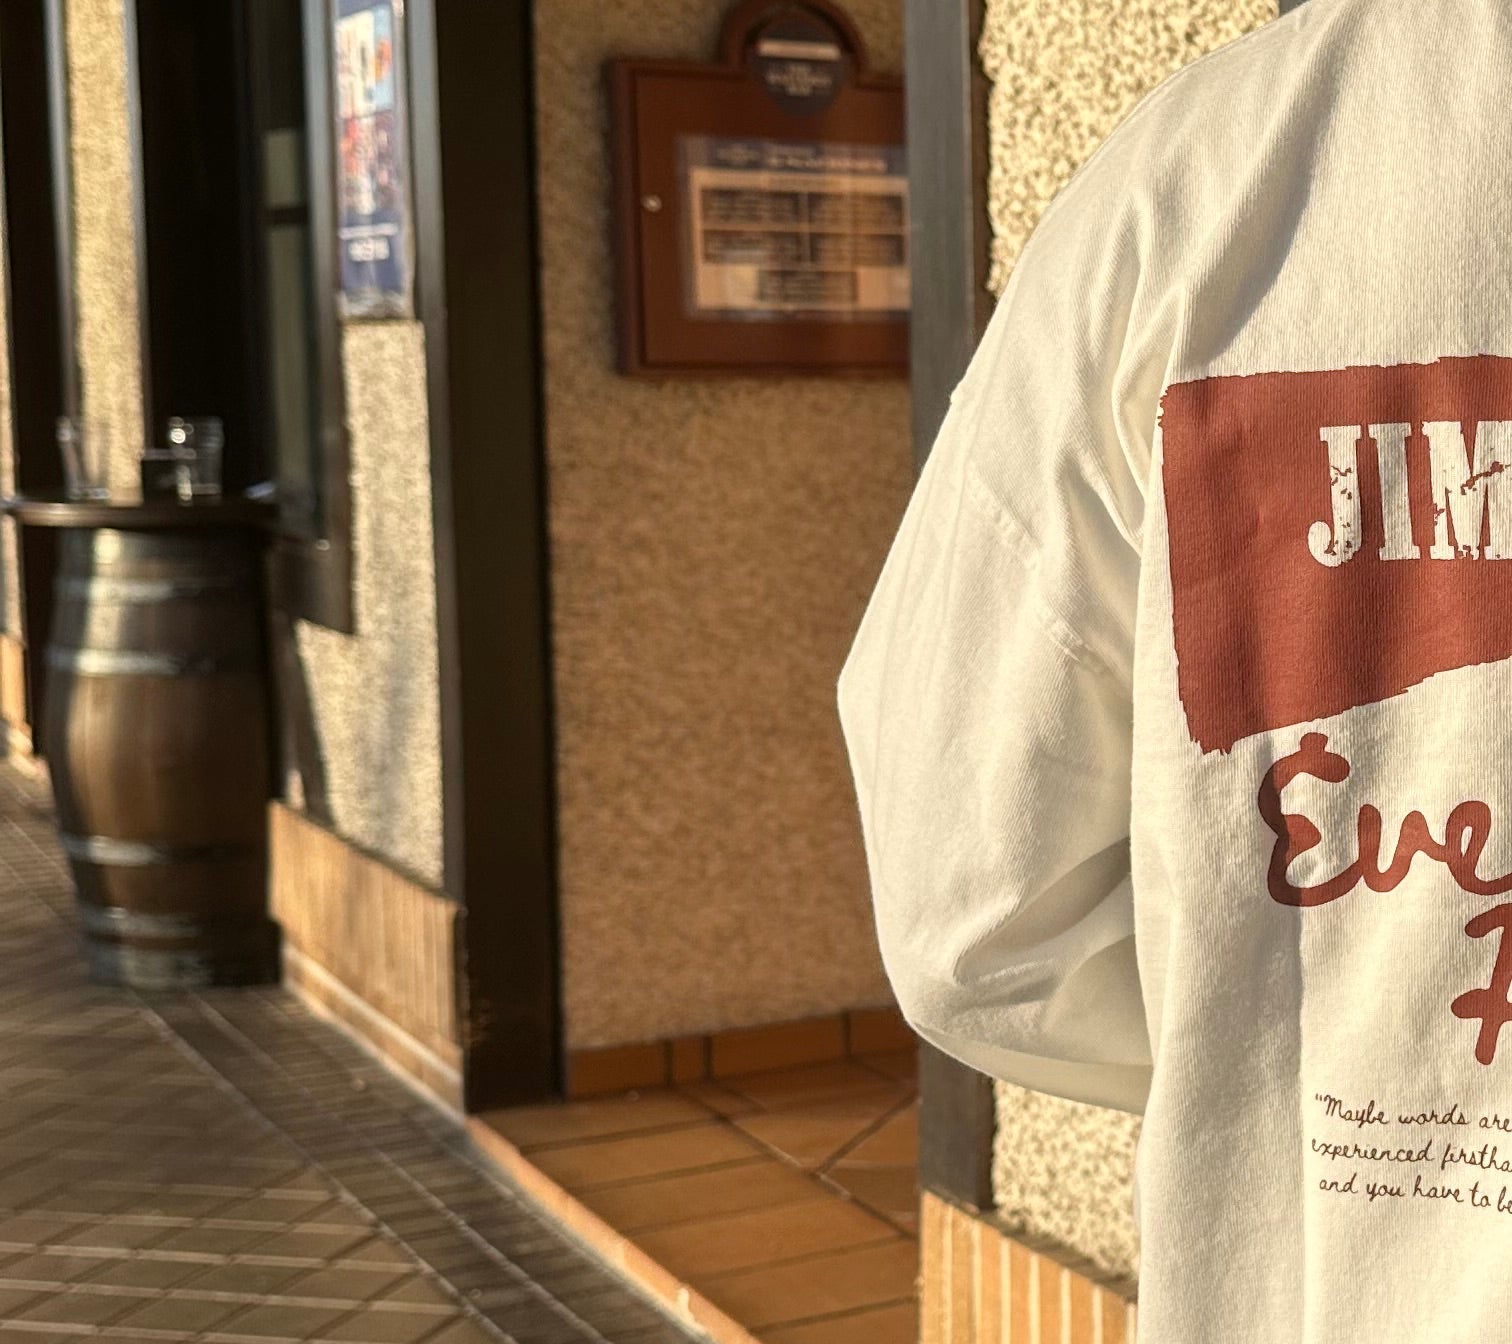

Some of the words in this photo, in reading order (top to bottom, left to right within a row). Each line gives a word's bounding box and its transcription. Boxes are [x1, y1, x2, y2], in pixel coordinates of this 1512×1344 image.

[1315, 1093, 1389, 1128] "Maybe
[1398, 1104, 1470, 1125] words
[1311, 1138, 1434, 1162] experienced
[1319, 1172, 1358, 1194] and
[1366, 1181, 1404, 1202] you
[1413, 1175, 1464, 1203] have
[1470, 1181, 1491, 1207] to
